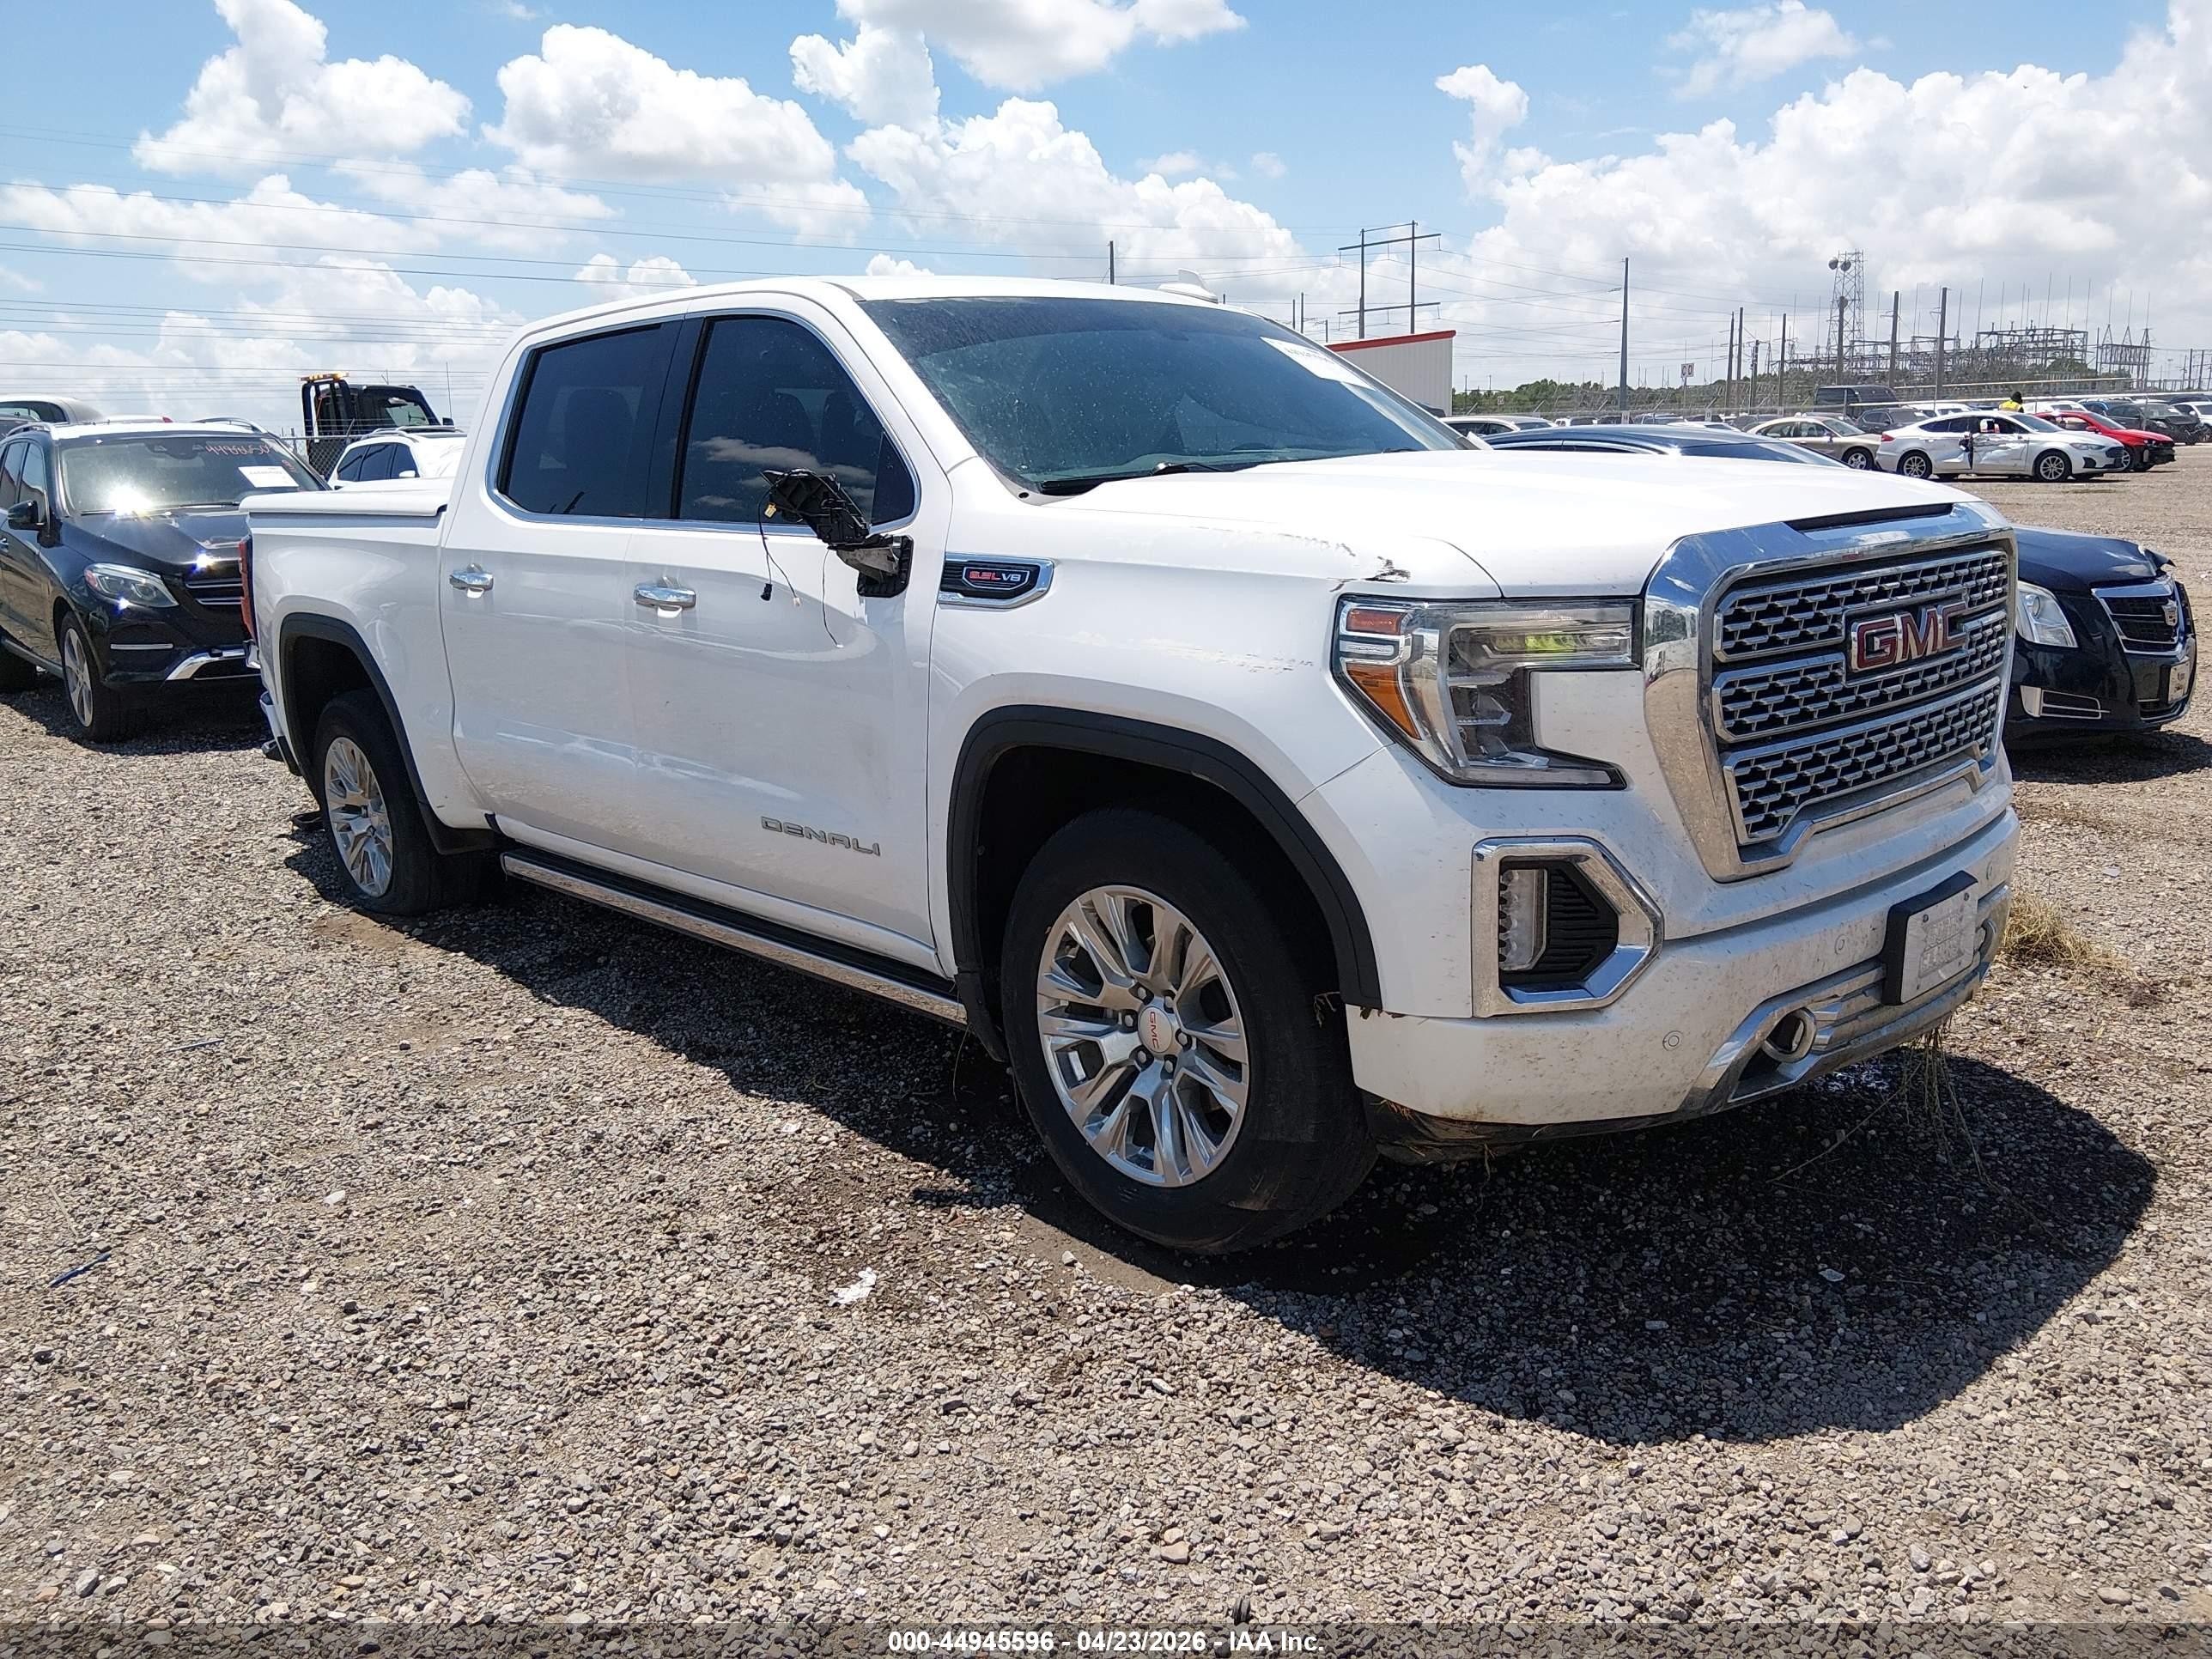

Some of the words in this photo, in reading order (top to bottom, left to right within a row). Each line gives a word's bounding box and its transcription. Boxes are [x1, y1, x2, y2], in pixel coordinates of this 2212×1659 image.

[1850, 601, 1968, 673] GMC
[761, 816, 881, 857] DENALI
[1150, 1011, 1159, 1049] GMC
